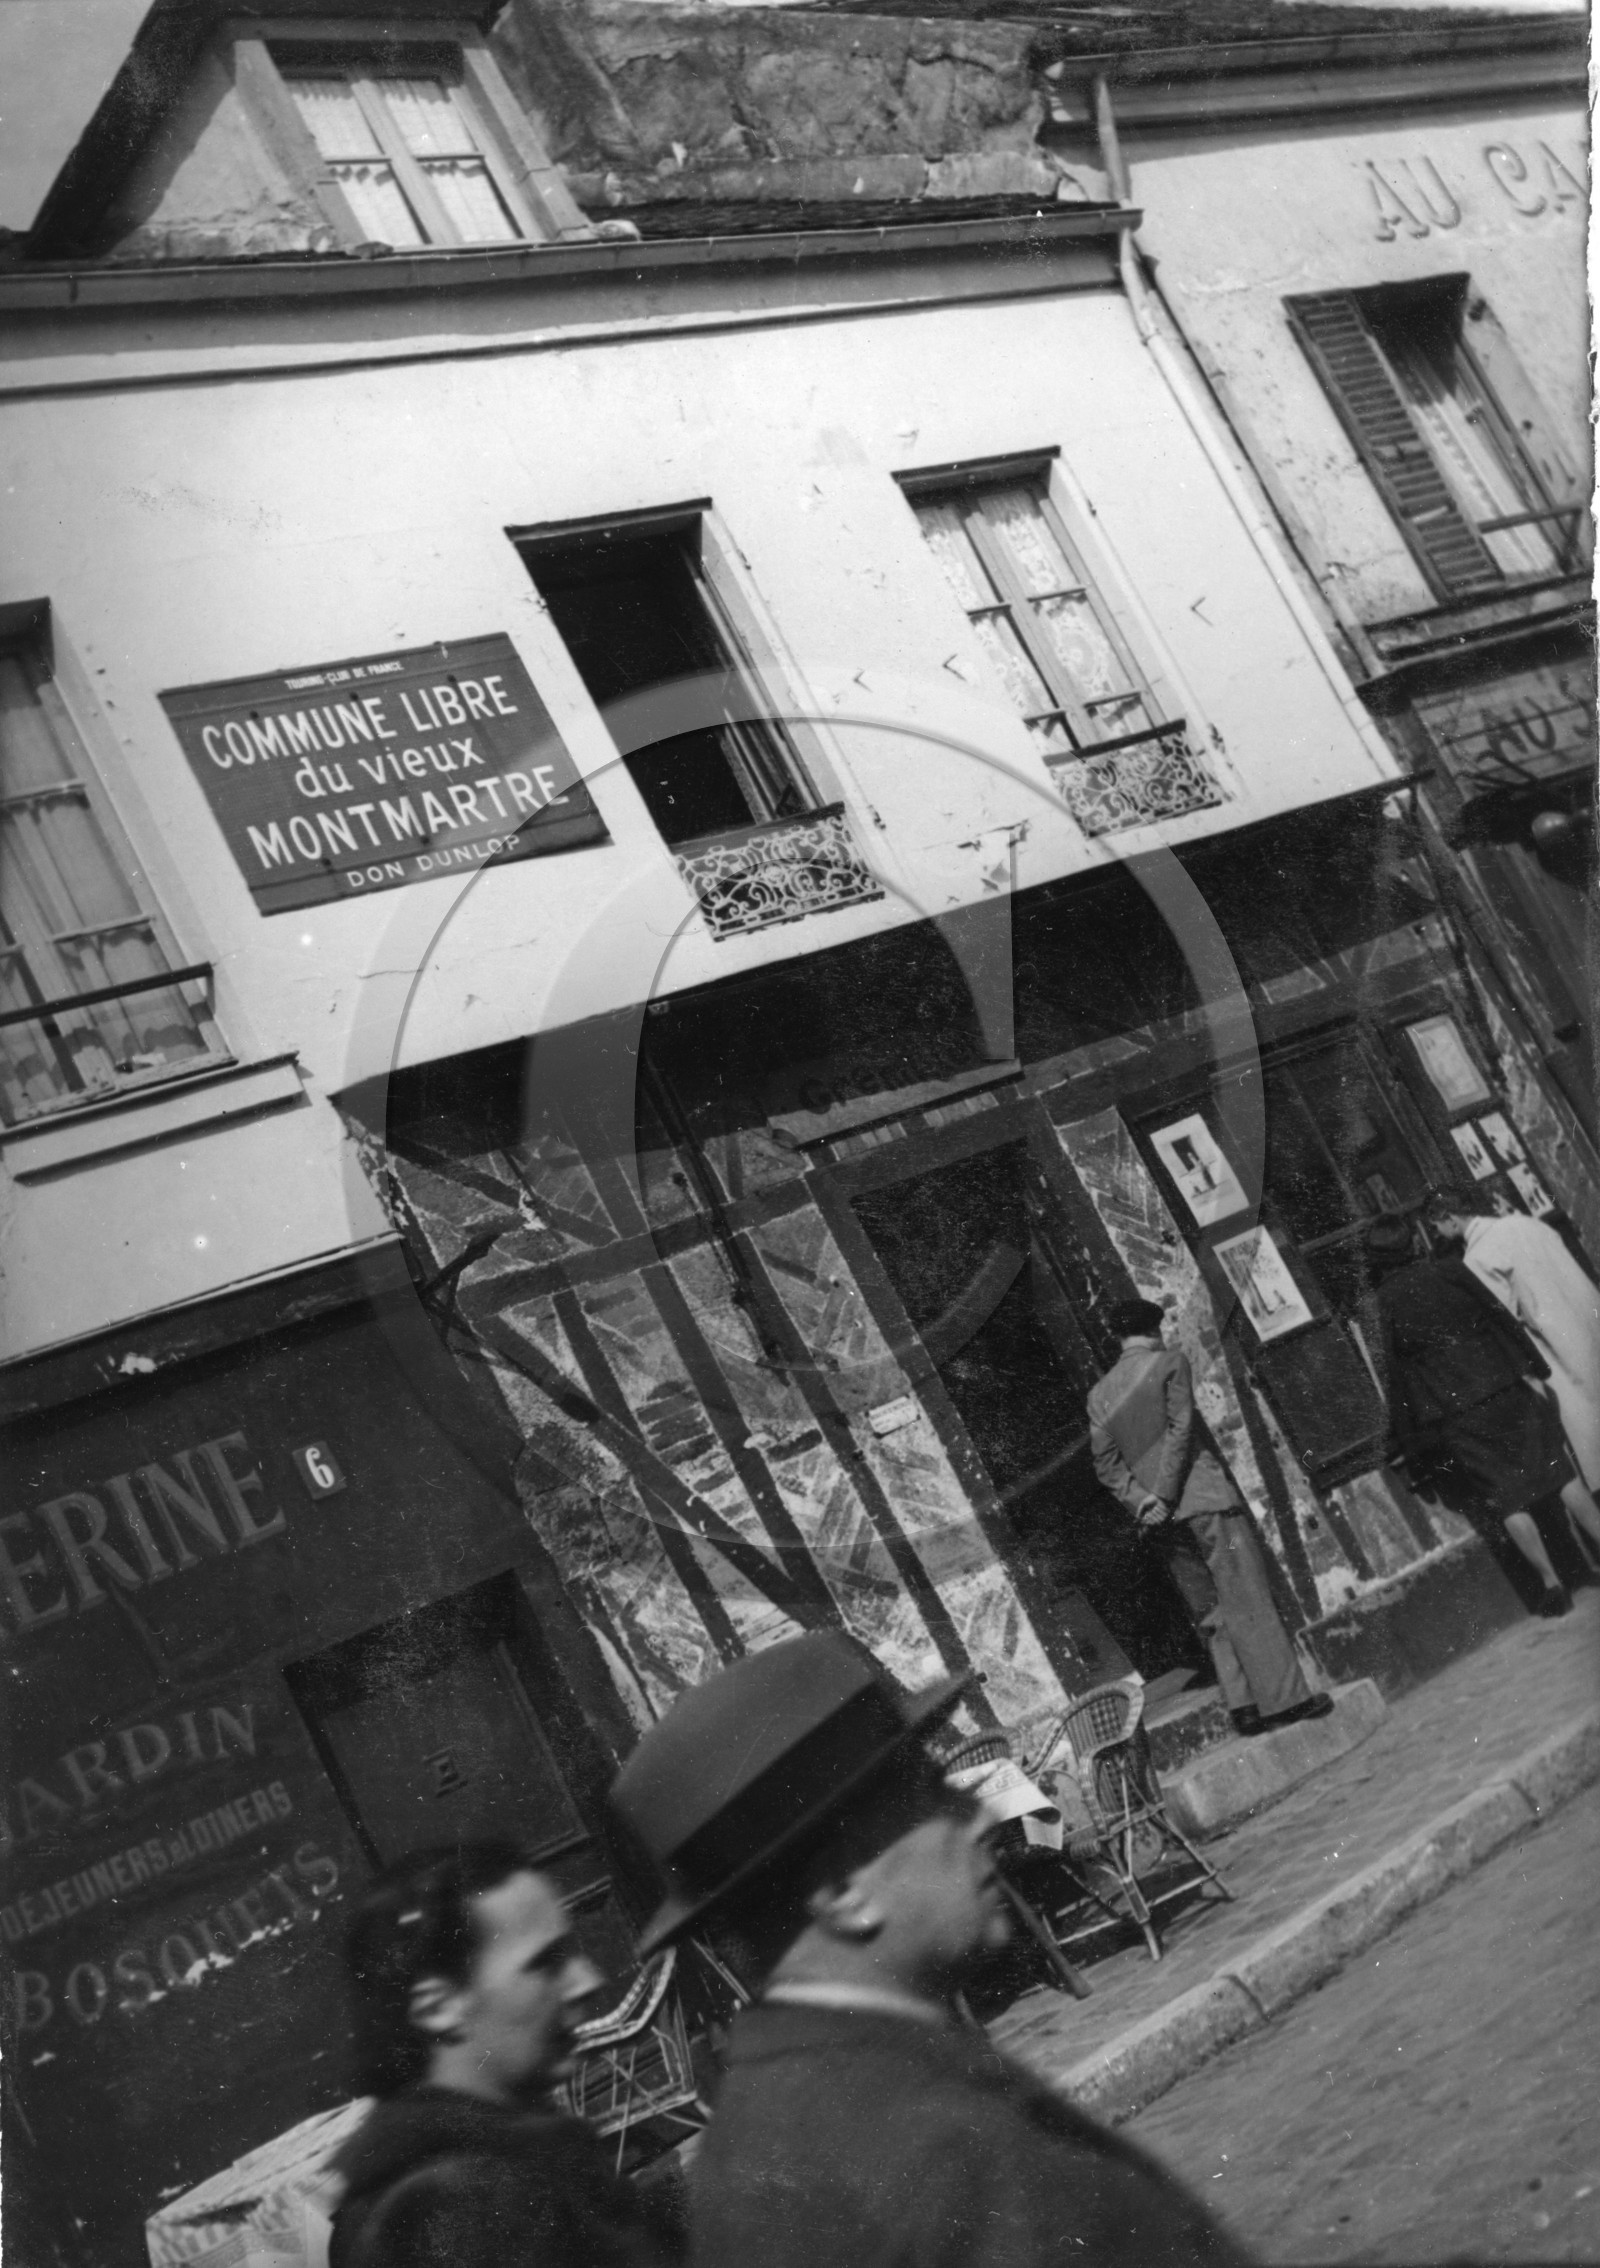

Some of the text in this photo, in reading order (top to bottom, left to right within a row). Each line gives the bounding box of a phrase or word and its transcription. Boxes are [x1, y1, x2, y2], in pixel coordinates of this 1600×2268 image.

[1362, 155, 1462, 242] AU
[352, 667, 367, 678] DE
[367, 660, 404, 675] FRANCE
[202, 676, 518, 769] COMMUNE LIBRE
[294, 737, 485, 798] du vieux
[246, 764, 569, 869] MONTMARTRE
[346, 834, 521, 888] DON DUNLOP
[304, 1446, 336, 1489] 6
[0, 1705, 257, 1850] ARDIN
